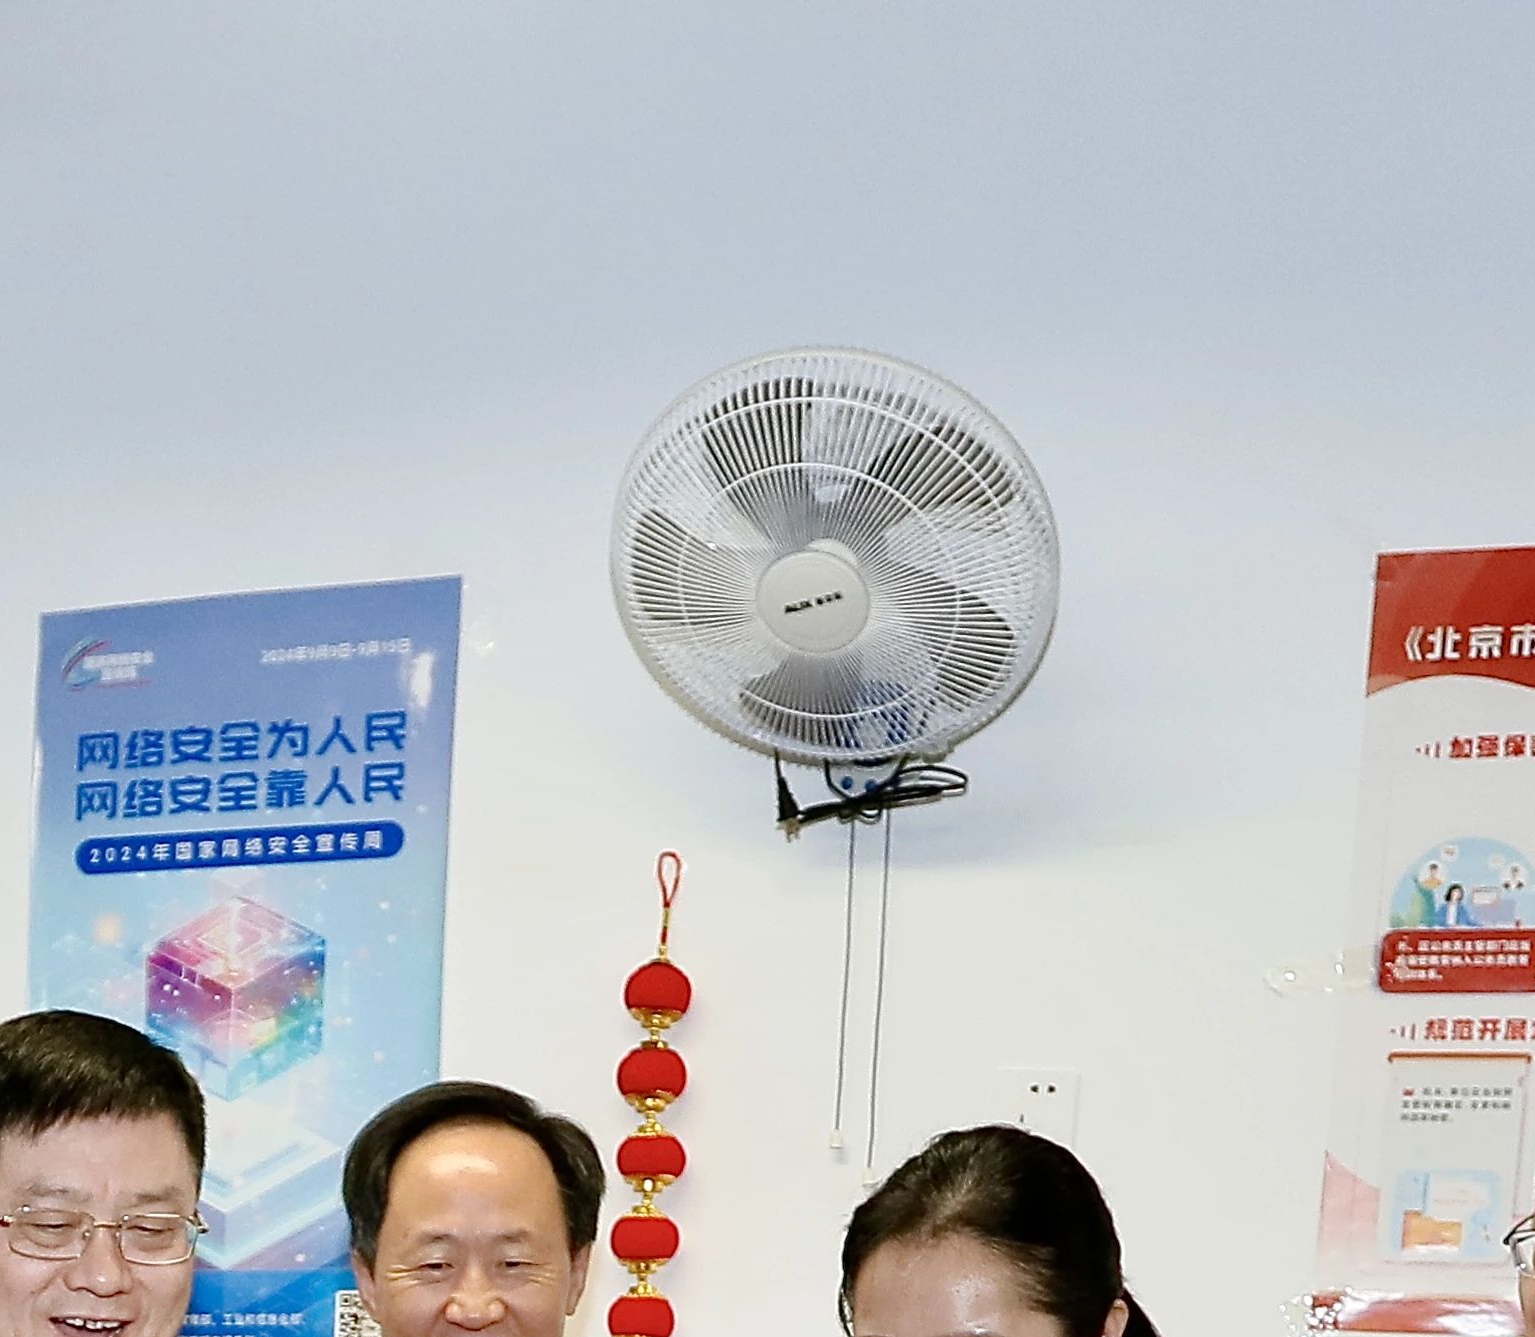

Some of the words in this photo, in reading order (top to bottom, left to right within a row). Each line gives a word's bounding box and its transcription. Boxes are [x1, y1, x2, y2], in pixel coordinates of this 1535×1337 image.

[75, 708, 407, 772] 网络安全为人民
[75, 760, 406, 822] 网络安全靠人民
[89, 829, 383, 863] 2024年国家网络安全宣传周
